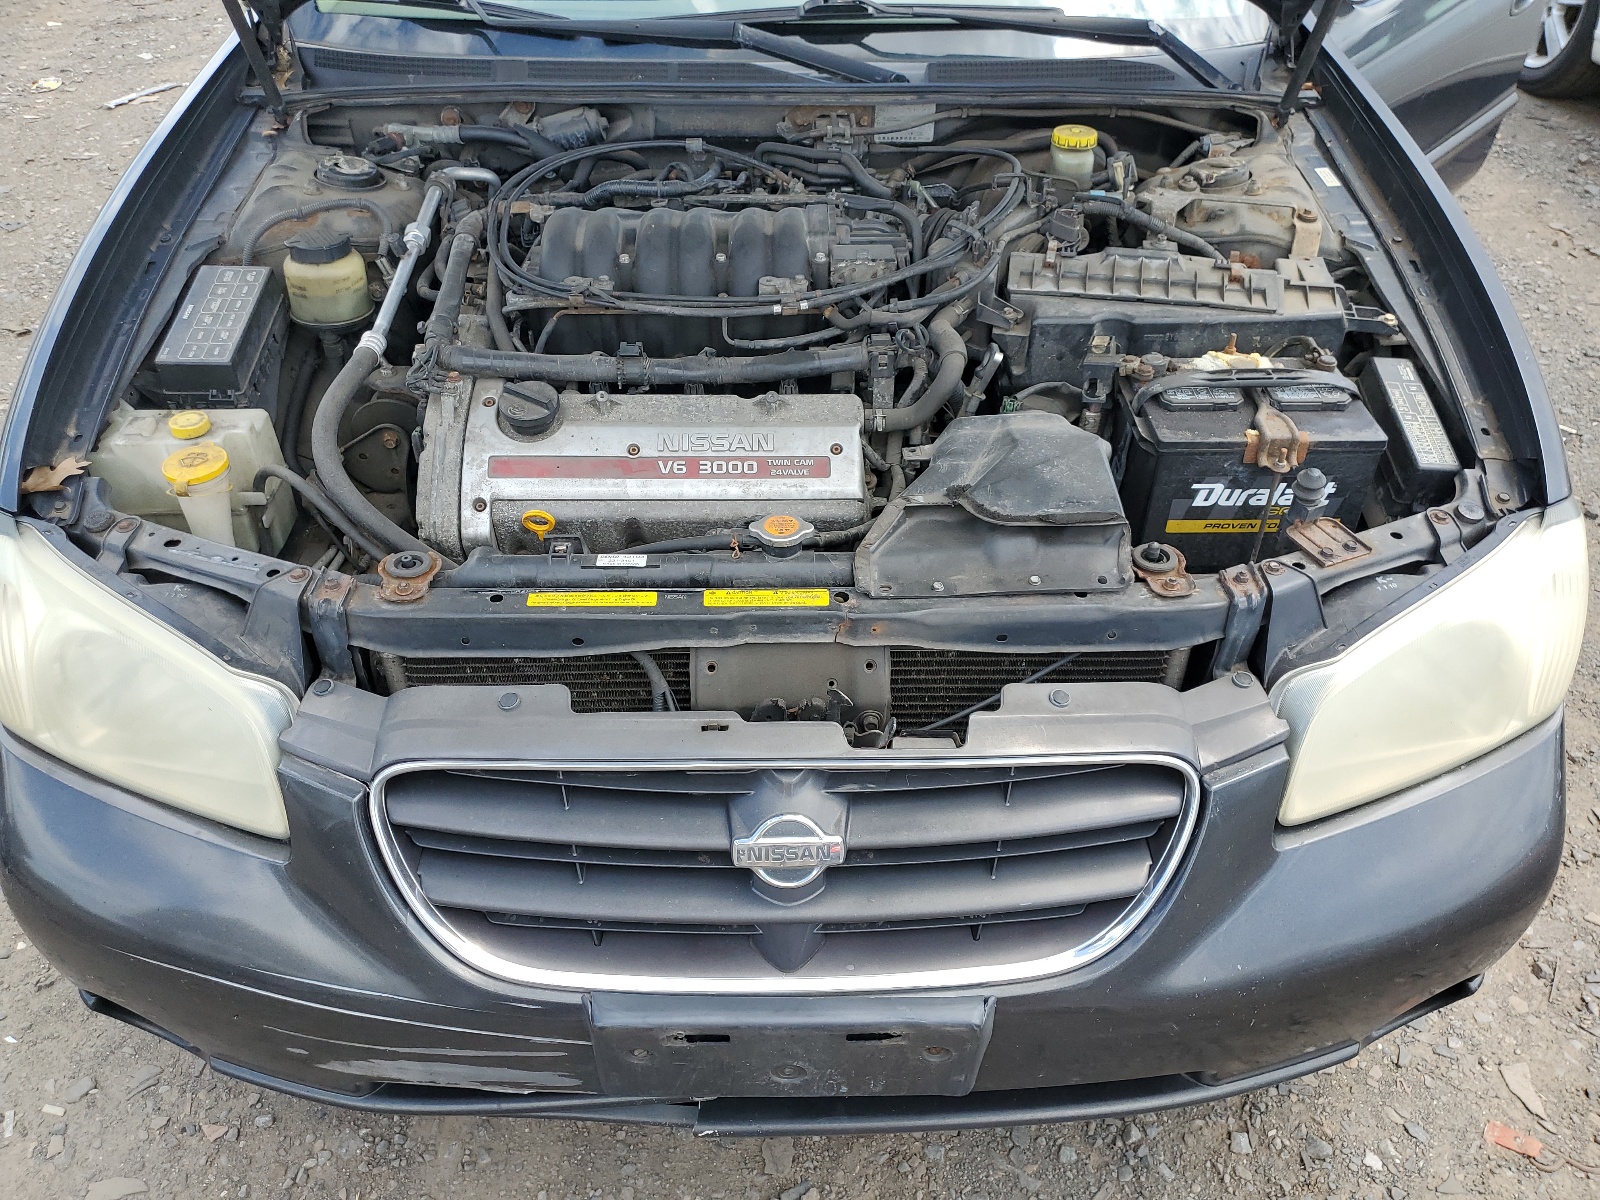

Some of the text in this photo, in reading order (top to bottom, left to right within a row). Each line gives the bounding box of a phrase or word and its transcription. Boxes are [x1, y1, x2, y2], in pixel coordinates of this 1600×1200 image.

[656, 433, 775, 452] NISSAN
[657, 460, 758, 474] V6 3000
[770, 468, 810, 476] 24VALVE
[747, 842, 831, 863] NISSAN
